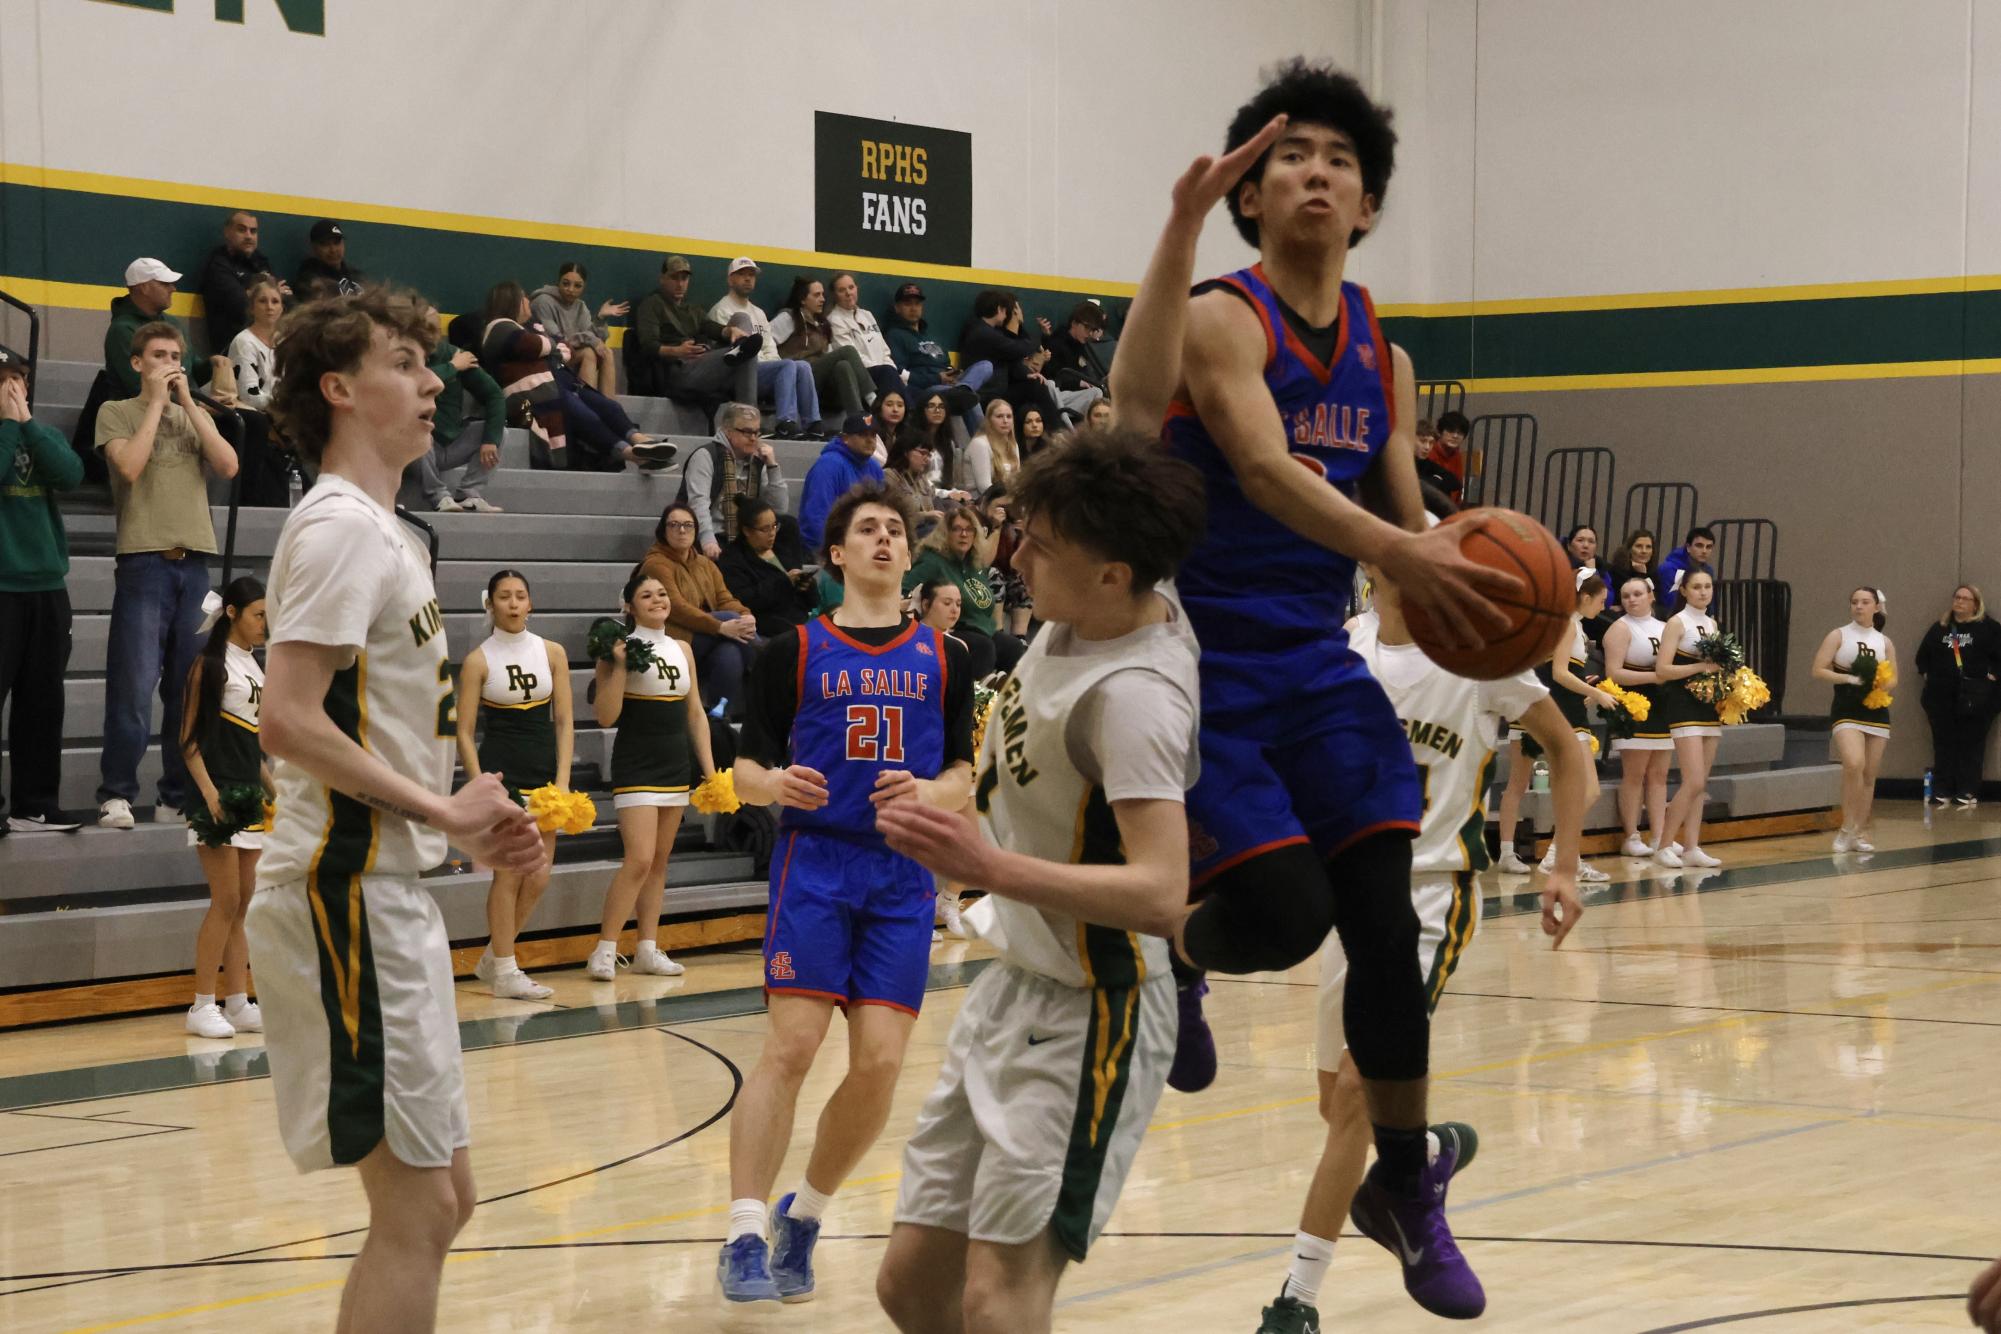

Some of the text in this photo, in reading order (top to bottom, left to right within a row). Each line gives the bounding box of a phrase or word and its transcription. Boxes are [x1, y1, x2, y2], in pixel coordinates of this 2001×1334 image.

[861, 139, 928, 186] RPHS
[862, 191, 928, 236] FANS
[1294, 403, 1370, 453] SALLE
[505, 663, 538, 701] RP
[656, 656, 681, 690] RP
[821, 668, 929, 701] LA SALLE
[244, 674, 263, 718] R
[845, 704, 905, 763] 21
